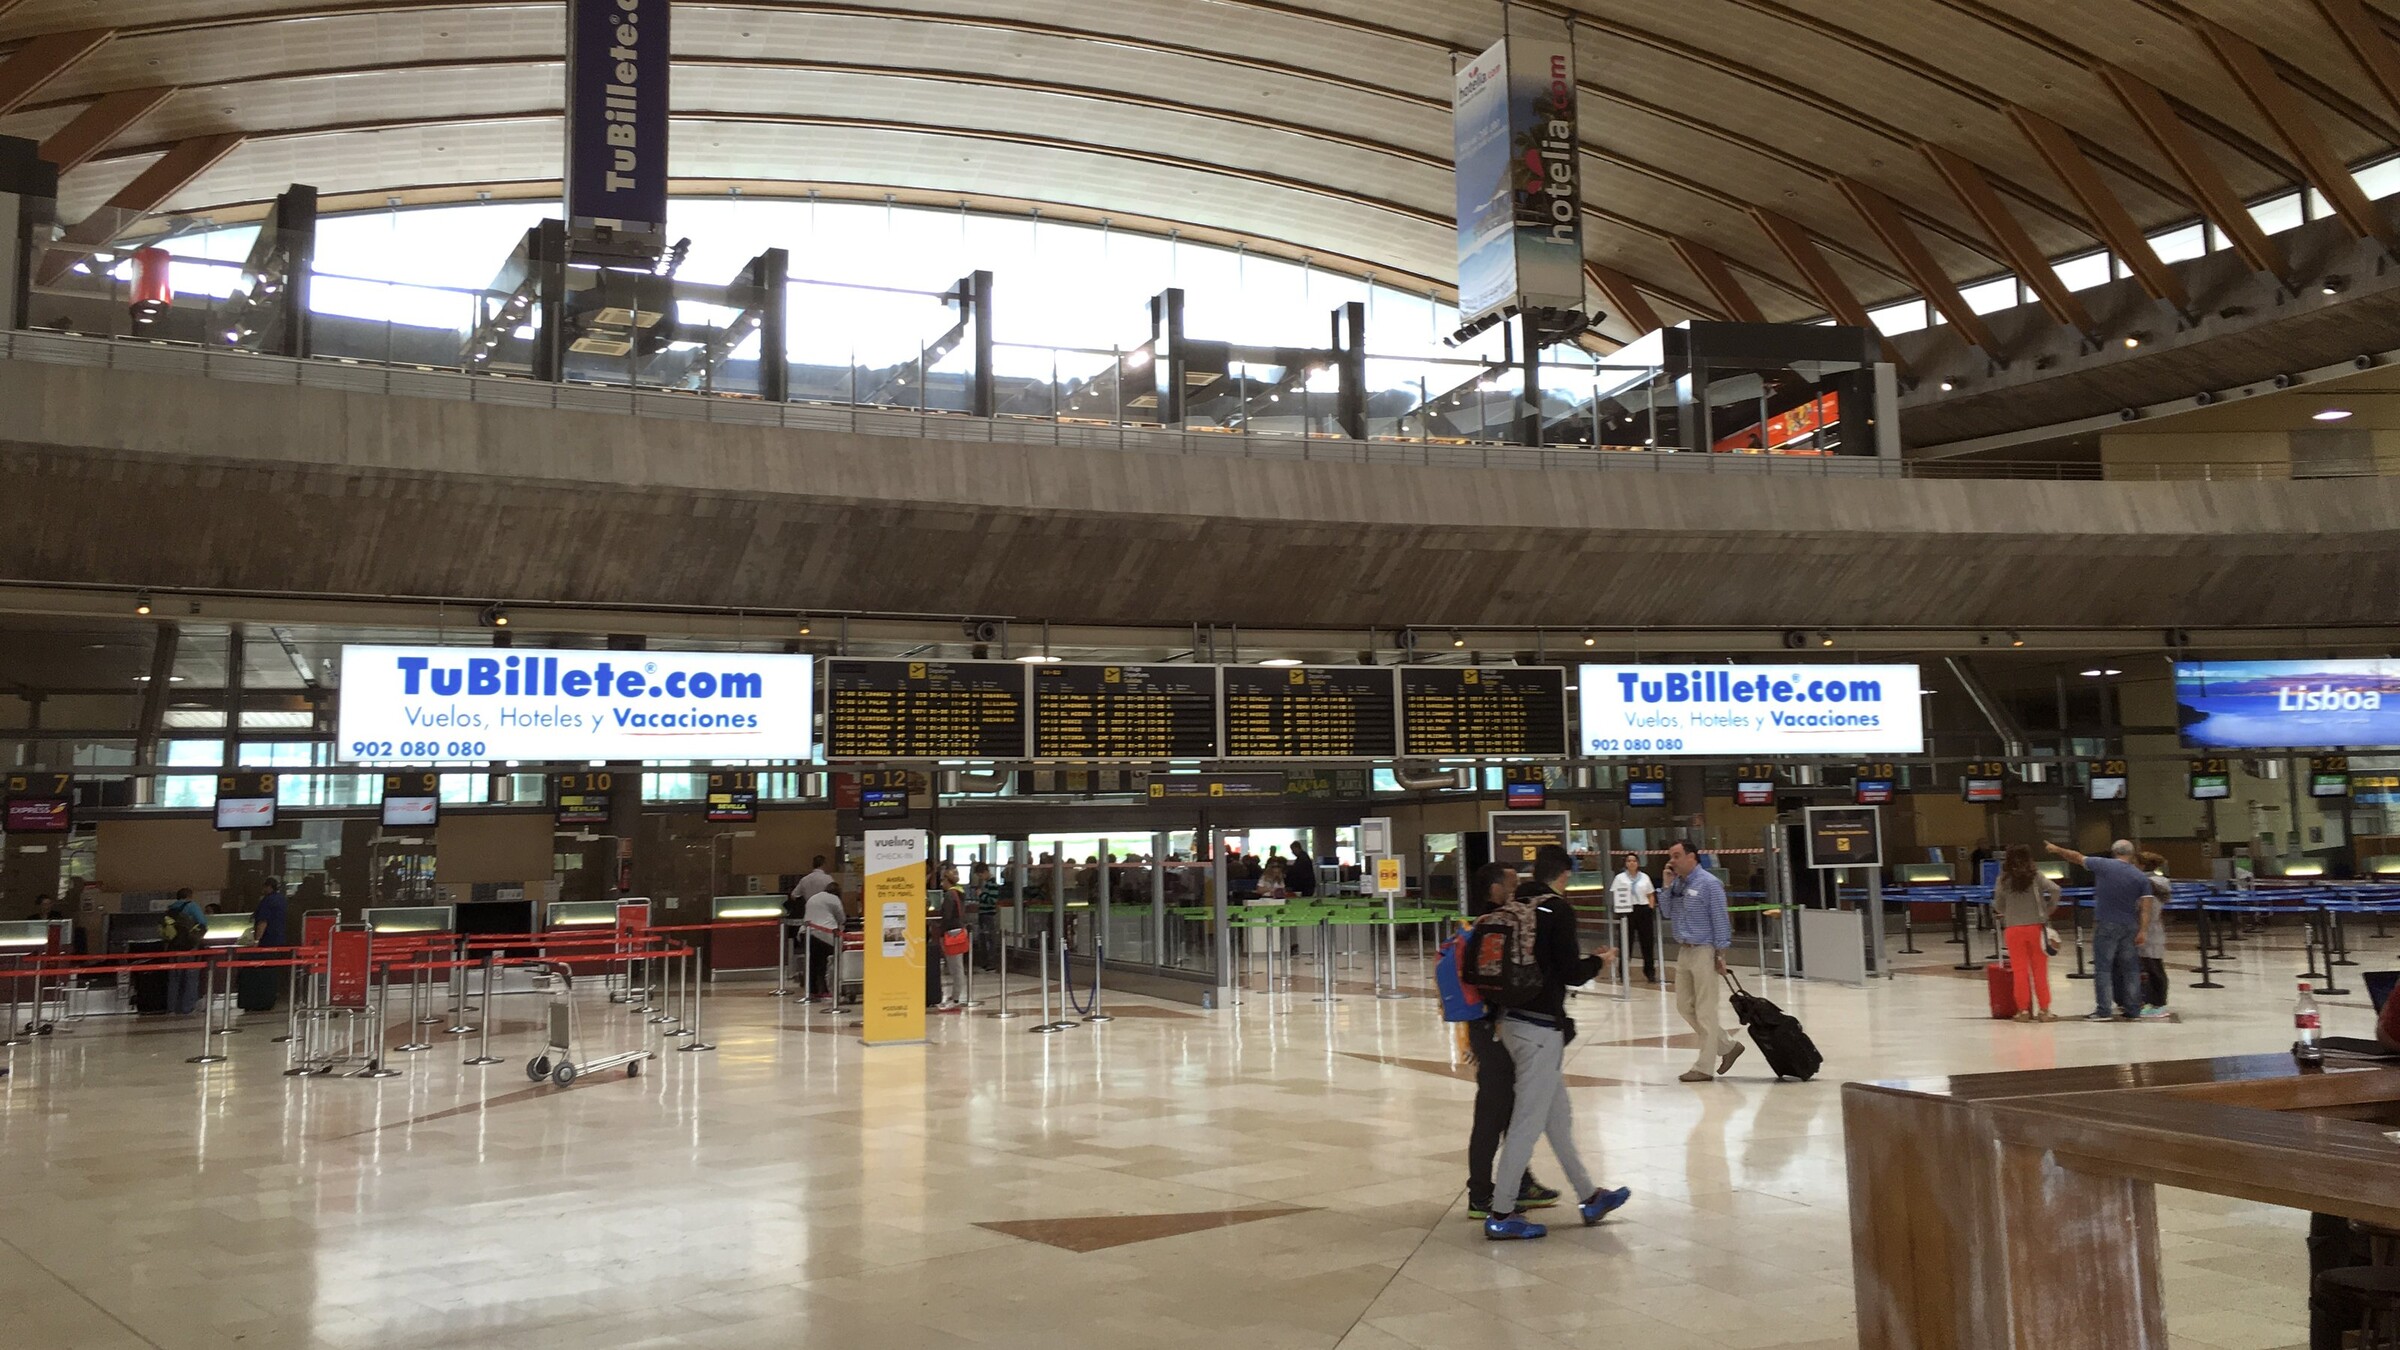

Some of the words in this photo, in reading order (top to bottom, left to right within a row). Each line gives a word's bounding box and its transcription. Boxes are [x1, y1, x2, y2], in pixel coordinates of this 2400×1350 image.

[1542, 54, 1575, 246] hotelia.com
[2278, 685, 2381, 712] Lisboa
[404, 706, 489, 731] Vuelos,
[500, 705, 582, 728] Hoteles
[592, 713, 604, 734] y
[613, 707, 758, 729] Vacaciones
[1624, 708, 1684, 730] Vuelos,
[1690, 708, 1750, 727] Hoteles
[1755, 715, 1765, 731] y
[1770, 710, 1880, 727] Vacaciones
[352, 741, 393, 758] 902
[400, 741, 440, 757] 080
[446, 741, 486, 757] 080
[1591, 739, 1620, 750] 902
[1624, 739, 1651, 750] 080
[1656, 739, 1683, 750] 080
[1754, 765, 1773, 778] 17
[1874, 764, 1894, 778] 18
[1984, 762, 2002, 776] 19
[2105, 760, 2126, 774] 20
[2208, 760, 2226, 772] 21
[2326, 757, 2347, 770] 22
[734, 772, 756, 789] 11
[883, 770, 906, 787] 12
[1524, 766, 1543, 781] 15
[1646, 765, 1664, 780] 16
[54, 774, 69, 794] 7
[259, 774, 275, 793] 8
[422, 774, 436, 792] 9
[586, 774, 612, 791] 10
[874, 836, 914, 849] vueling
